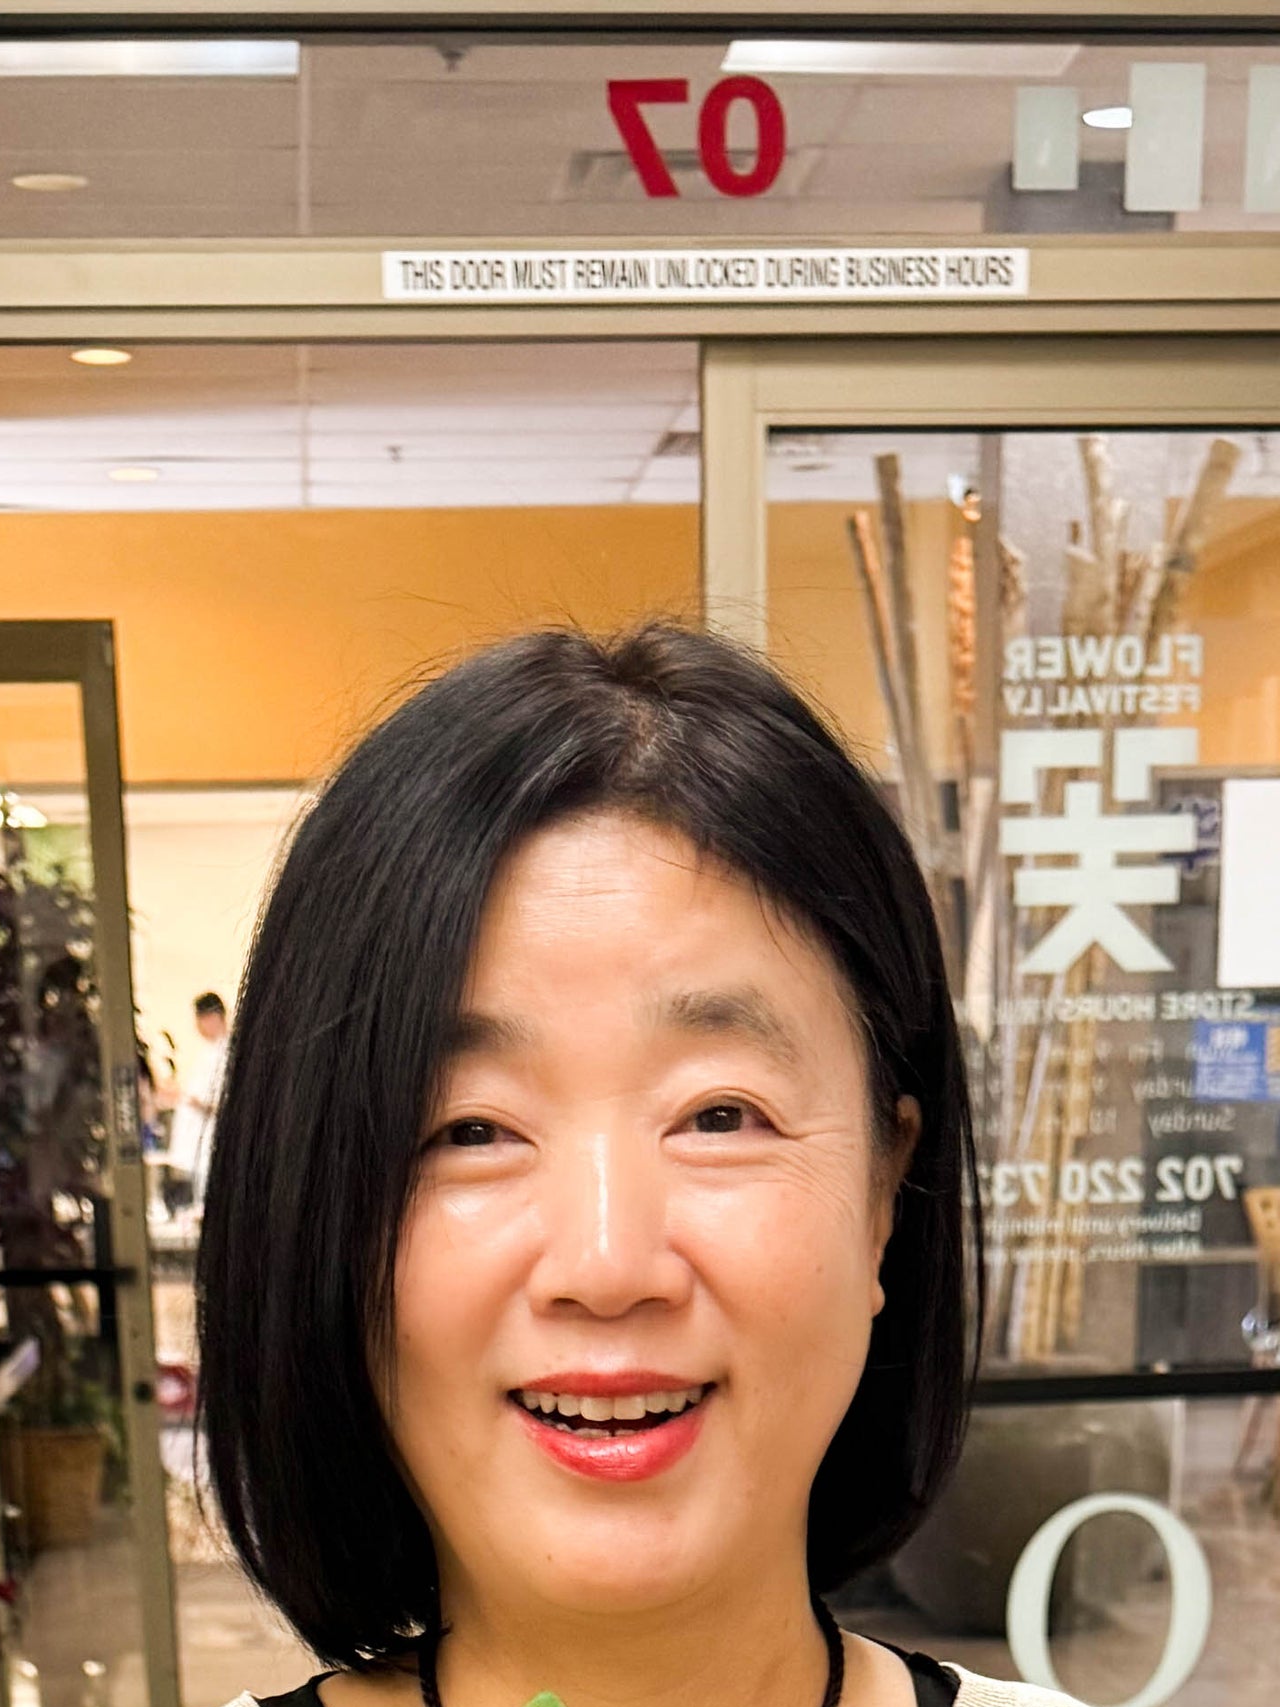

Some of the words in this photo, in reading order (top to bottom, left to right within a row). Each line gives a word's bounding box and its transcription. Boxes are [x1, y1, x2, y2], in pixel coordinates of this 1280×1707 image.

[401, 258, 445, 290] THIS
[449, 258, 508, 290] DOOR
[512, 258, 568, 290] MUST
[573, 258, 651, 289] REMAIN
[655, 257, 758, 289] UNLOCKED
[764, 257, 840, 288] DURING
[844, 256, 941, 288] BUSINESS
[945, 256, 1014, 288] HOURS
